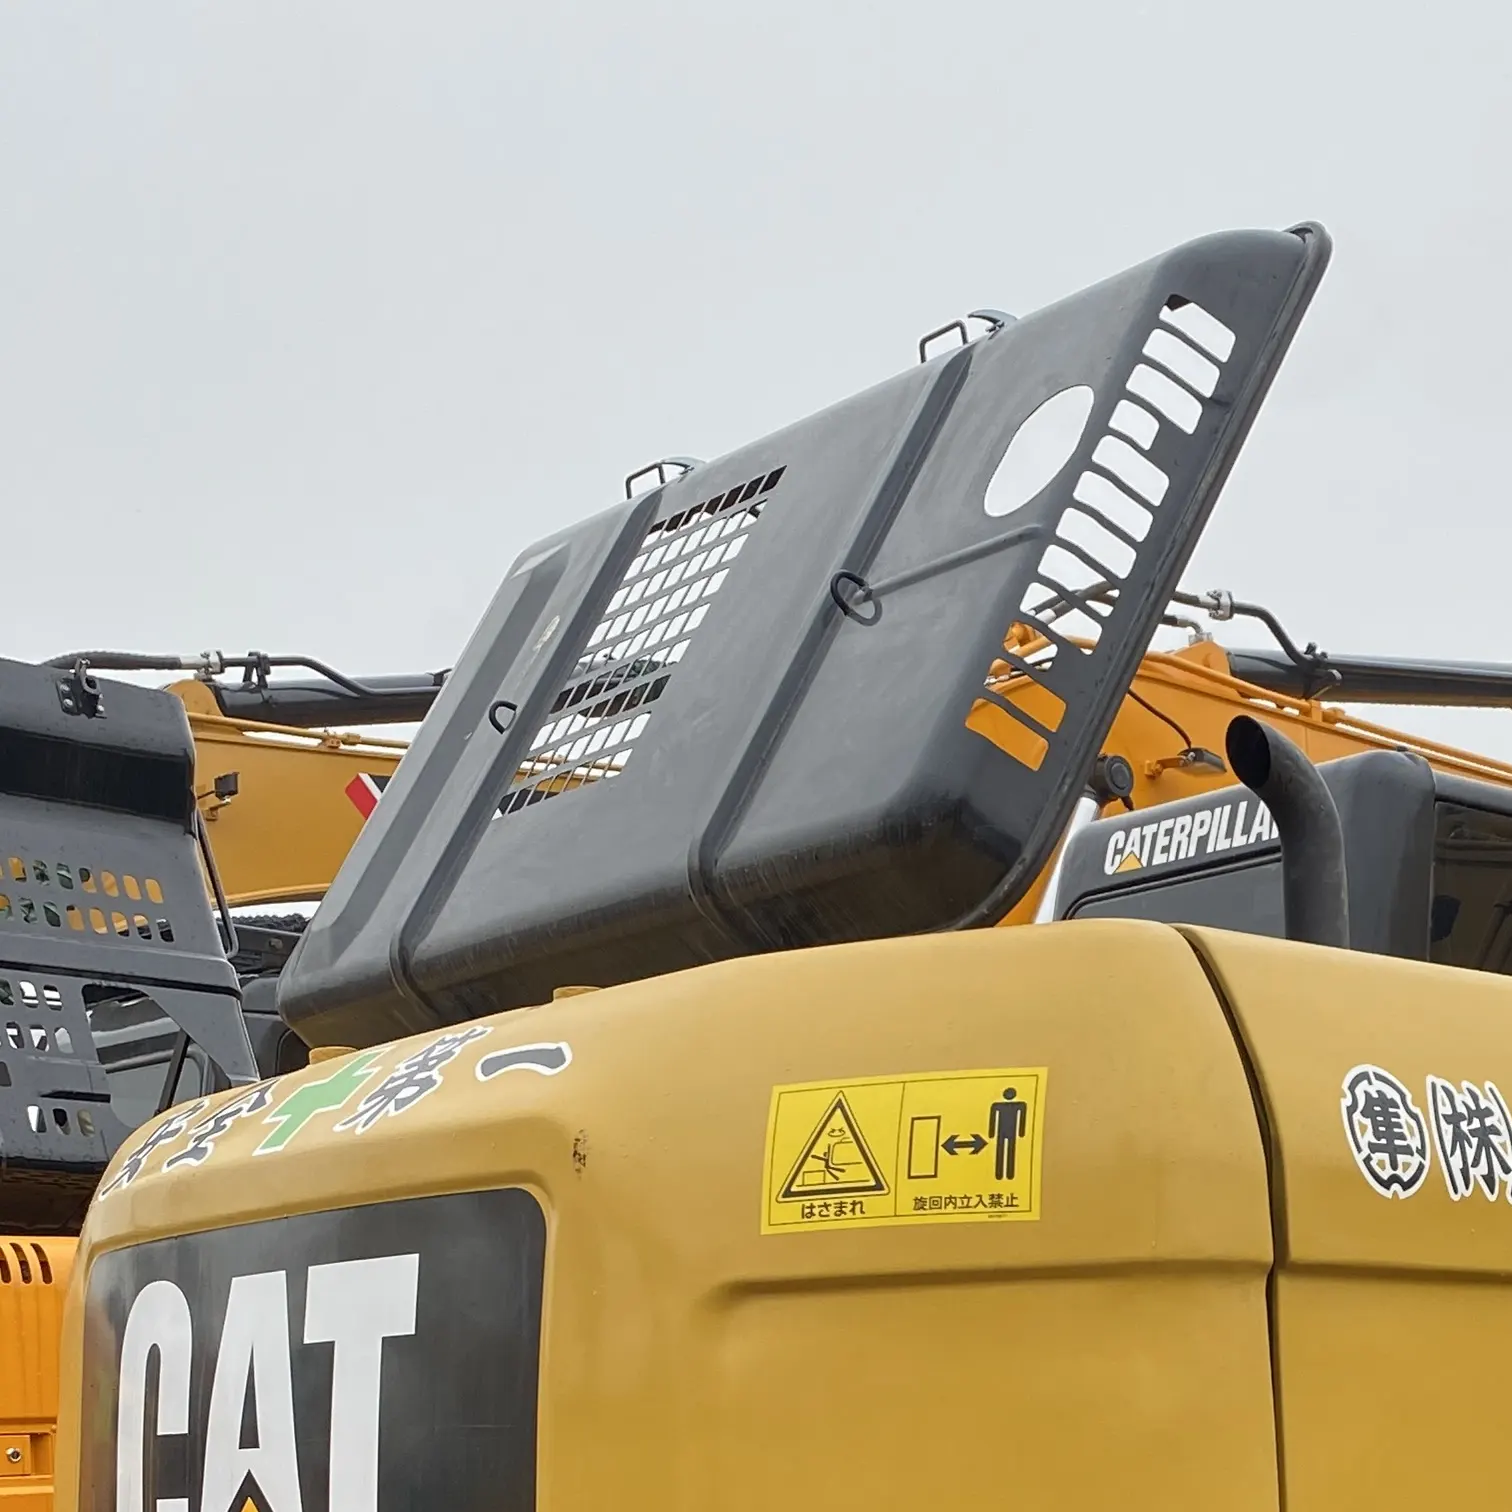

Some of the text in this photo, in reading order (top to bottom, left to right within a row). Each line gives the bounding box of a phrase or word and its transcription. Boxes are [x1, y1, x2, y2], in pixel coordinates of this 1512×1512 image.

[801, 1200, 866, 1219] はさまれ
[912, 1193, 1019, 1211] 旋回内立入禁止
